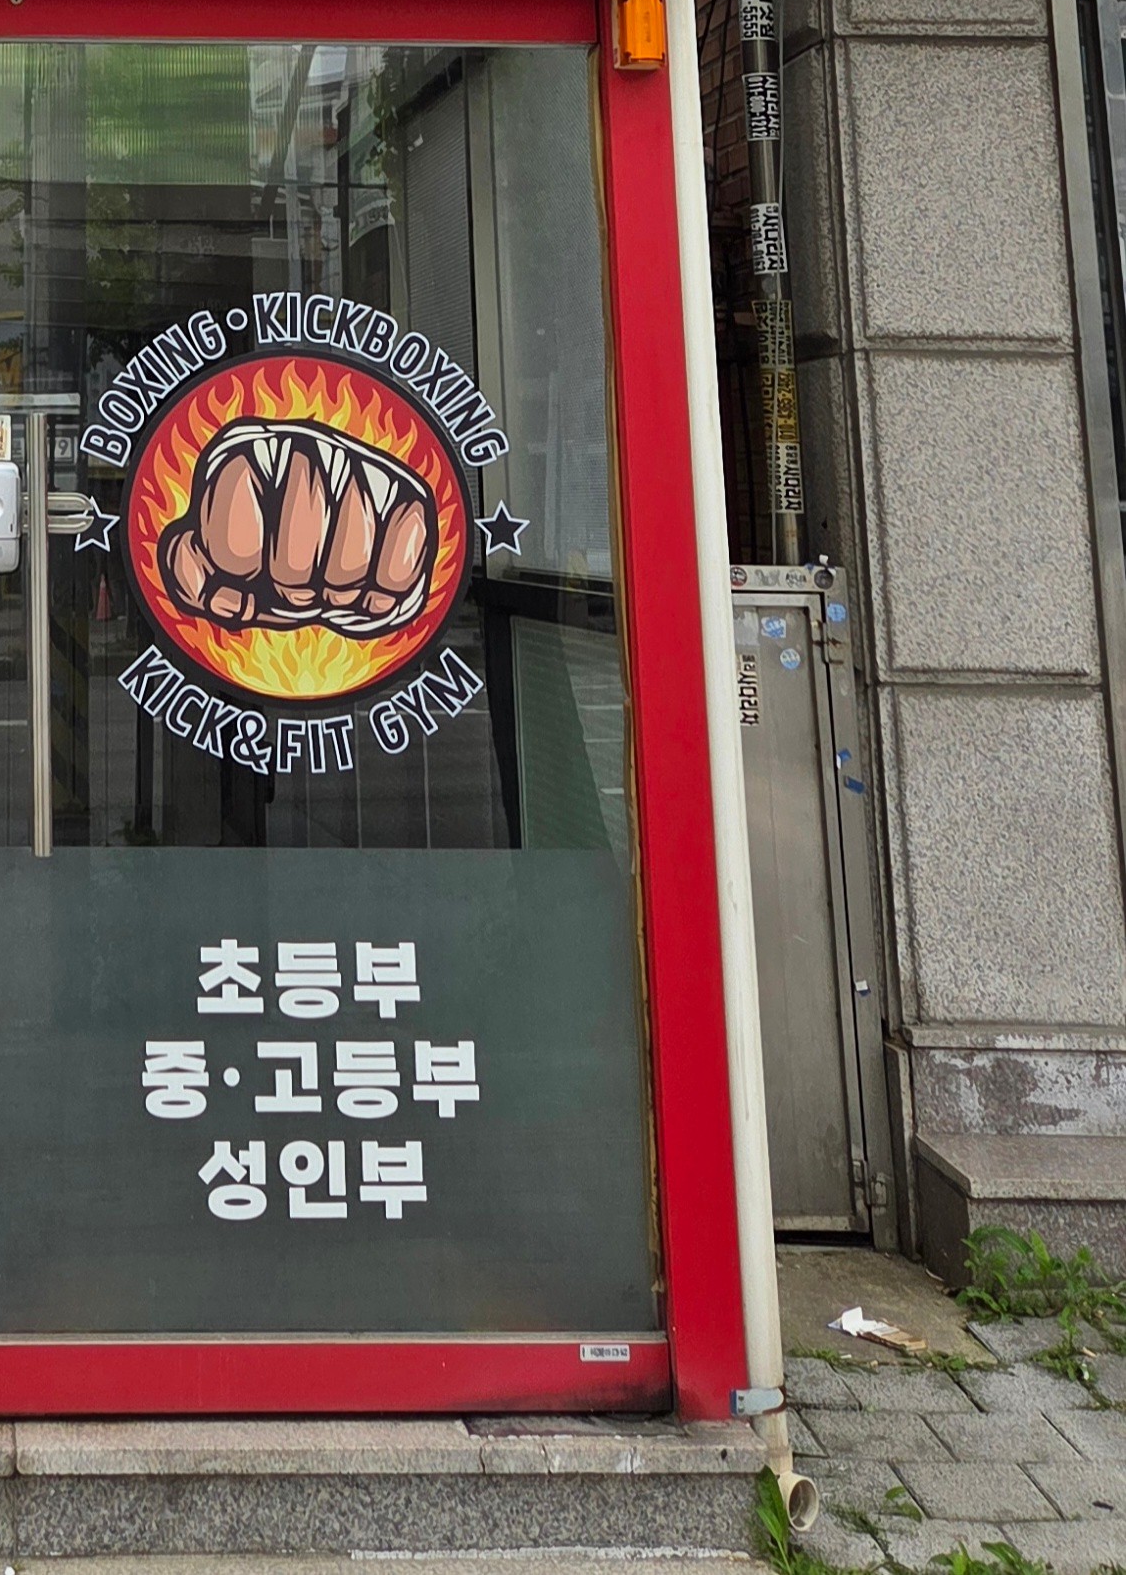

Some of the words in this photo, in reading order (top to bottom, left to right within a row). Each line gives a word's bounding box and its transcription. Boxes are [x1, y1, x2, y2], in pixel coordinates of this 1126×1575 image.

[370, 648, 485, 756] GYM
[197, 938, 420, 1018] 초등부
[198, 1140, 427, 1220] 성인부
